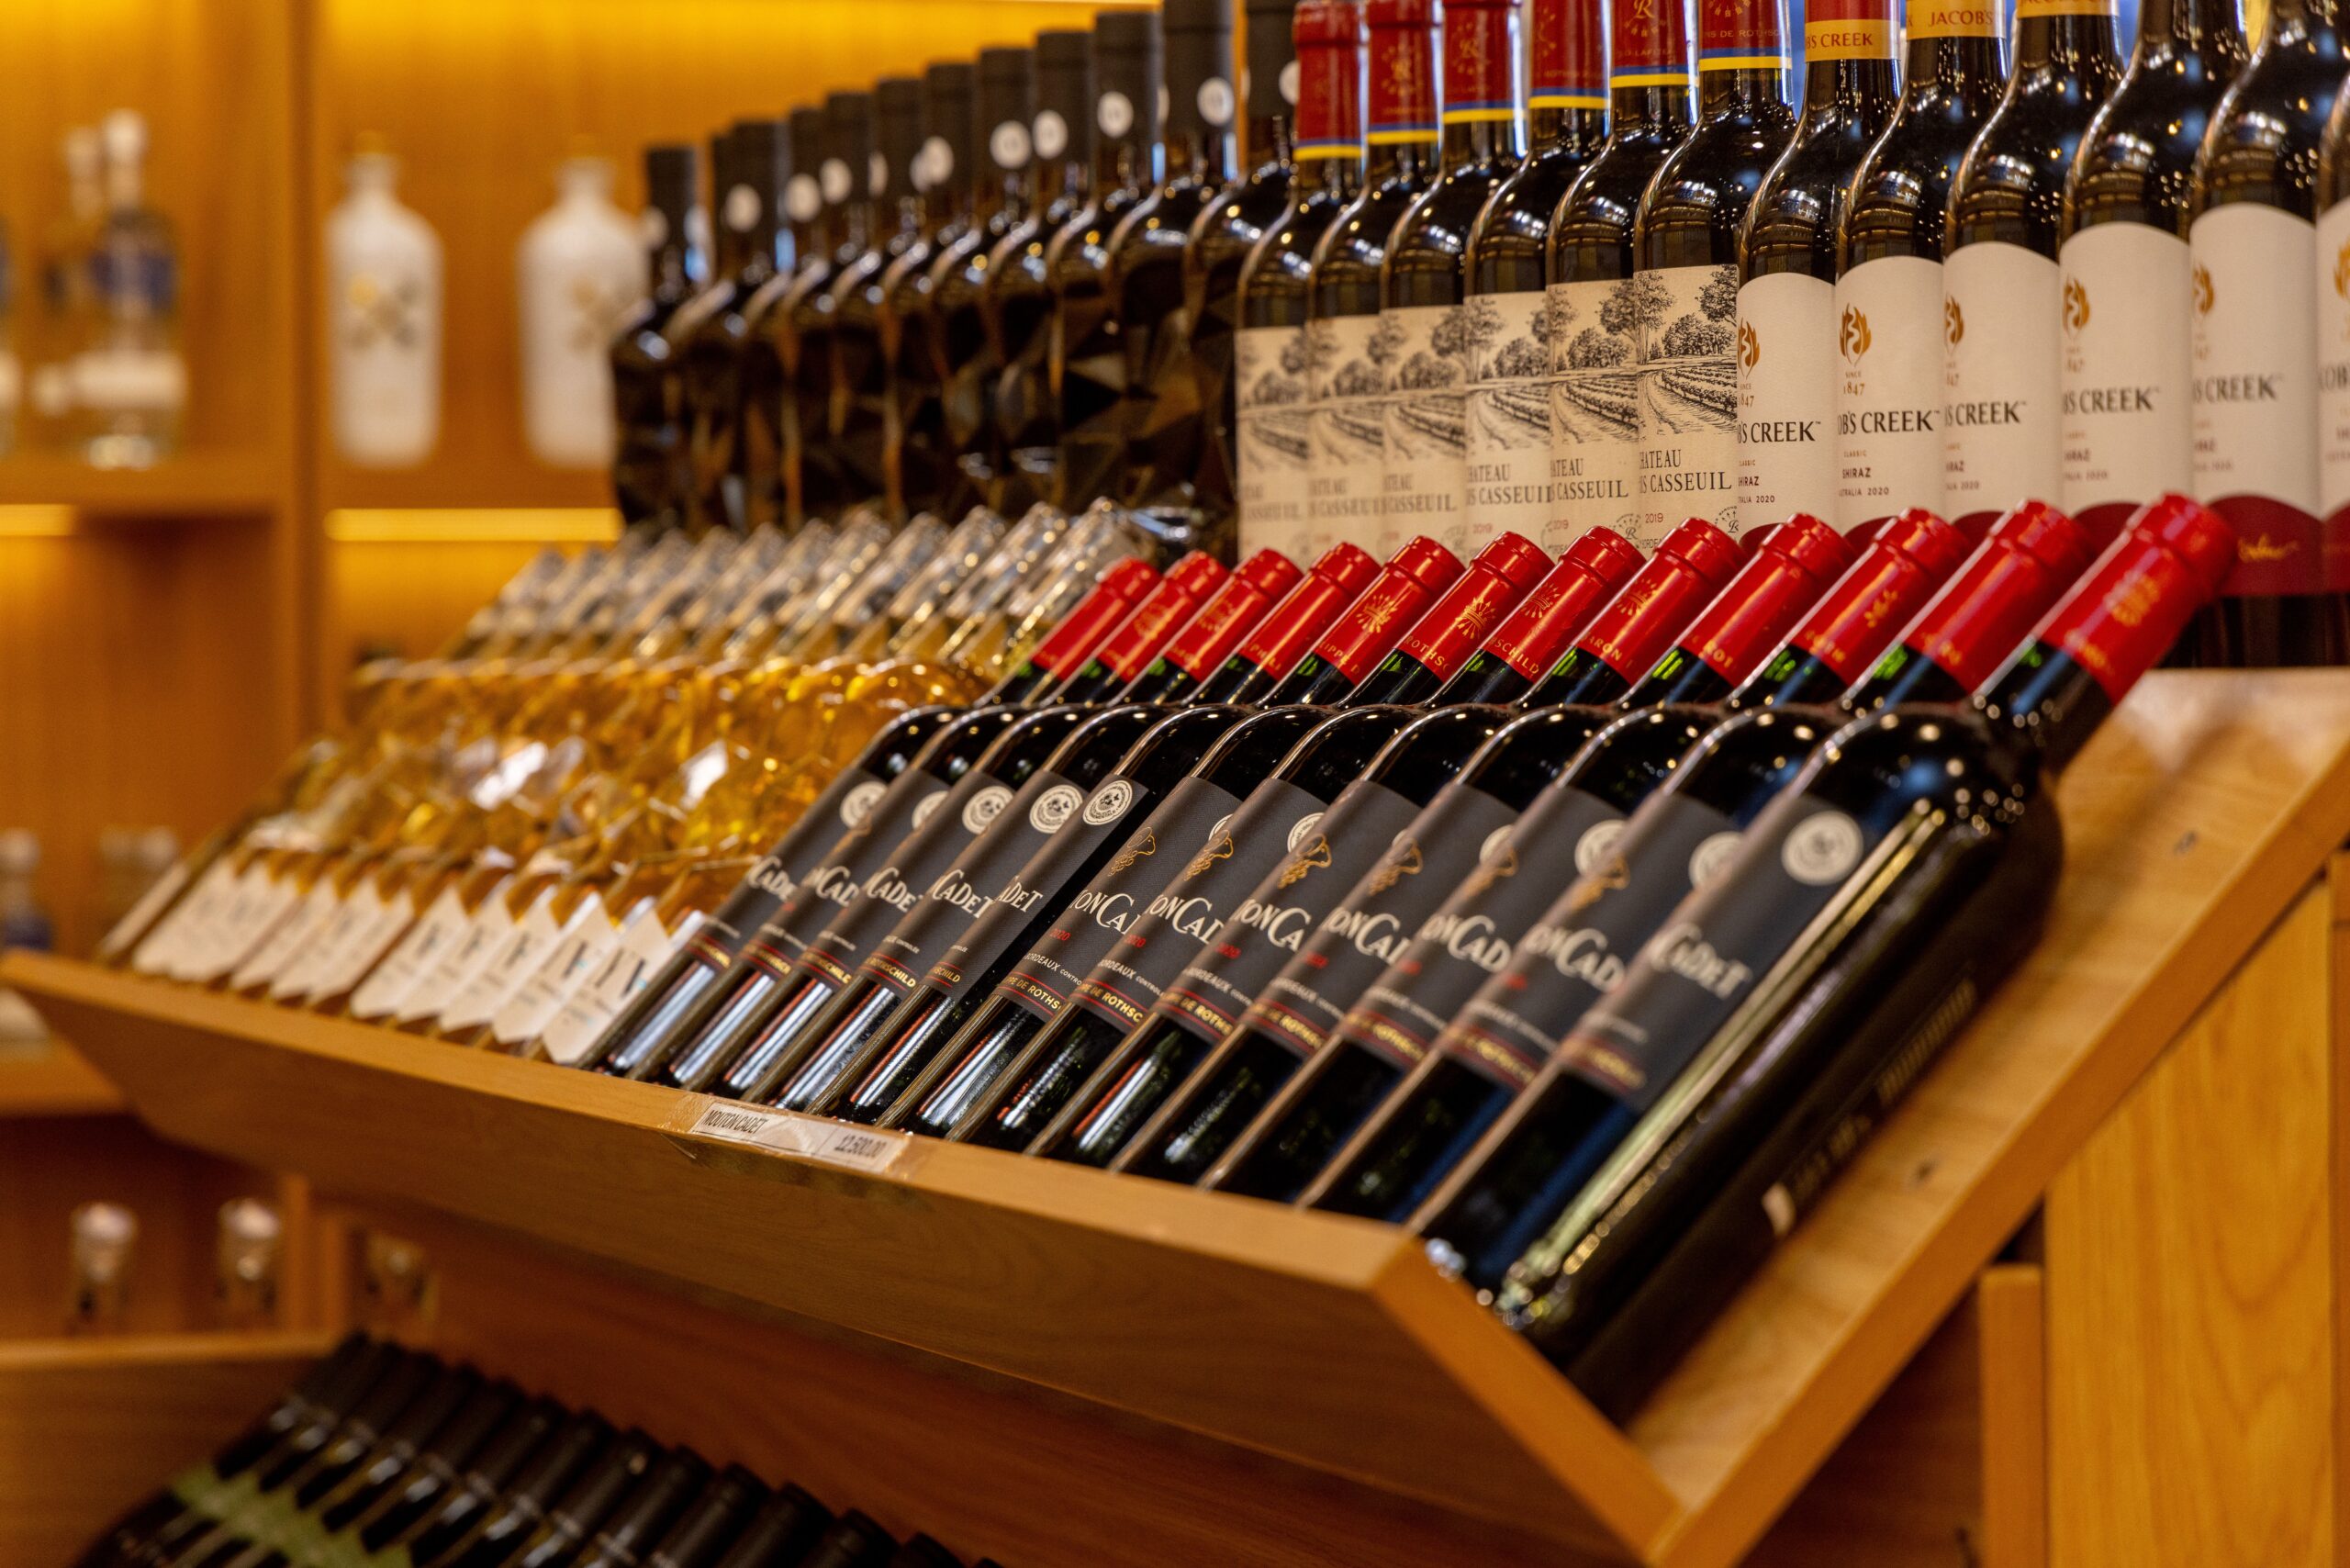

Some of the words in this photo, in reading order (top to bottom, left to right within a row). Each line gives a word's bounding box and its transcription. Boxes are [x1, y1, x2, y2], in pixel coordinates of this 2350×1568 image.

[1929, 10, 1994, 27] JACOB'S
[1820, 32, 1874, 48] CREEK
[1842, 382, 1865, 397] 1847
[1739, 395, 1755, 409] 847
[2079, 386, 2154, 414] CREEK
[1955, 399, 2021, 427] CREEK
[1650, 471, 1732, 493] CASSEUIL
[1841, 467, 1872, 480] SHIRAZ
[1557, 479, 1629, 501] CASSEUIL
[1755, 494, 1775, 504] 2020
[1867, 487, 1889, 497] 2020
[1644, 512, 1664, 523] 2019
[864, 867, 917, 913] CADE
[932, 868, 995, 919] CADET
[1027, 984, 1062, 1010] ROTHS
[701, 1109, 742, 1129] MOUTON
[733, 1115, 770, 1135] CADET
